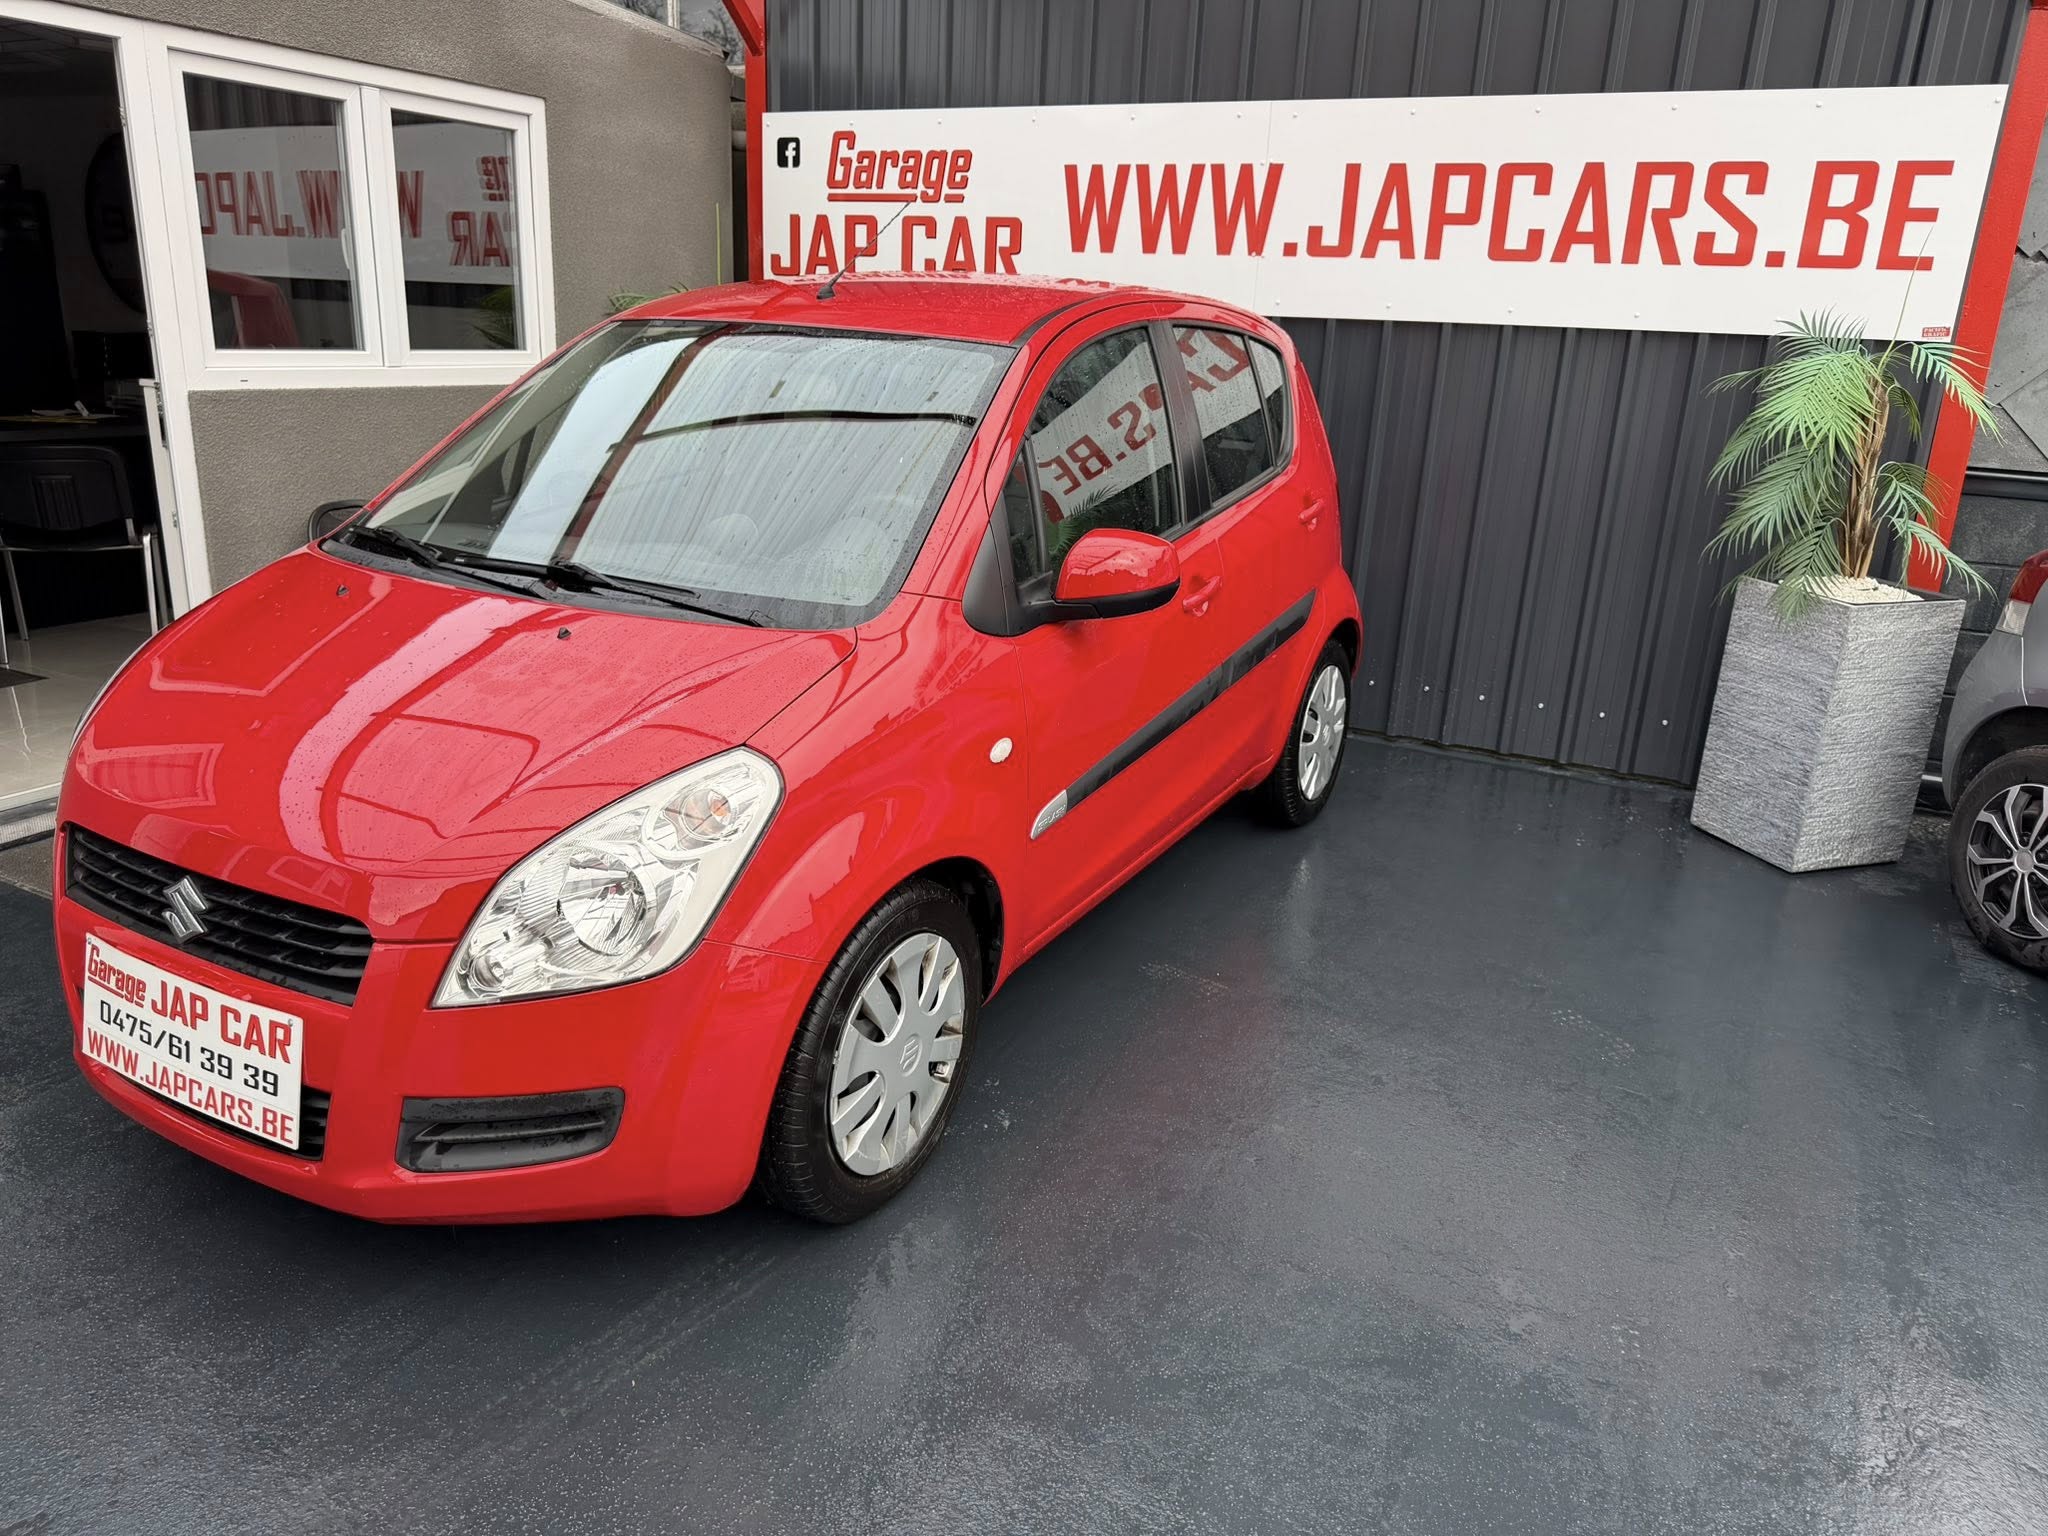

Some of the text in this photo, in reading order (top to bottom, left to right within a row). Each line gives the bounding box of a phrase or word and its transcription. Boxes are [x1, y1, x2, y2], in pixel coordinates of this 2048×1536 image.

[827, 130, 973, 202] Garage
[1064, 160, 1955, 270] WWW.JAPCARS.BE
[771, 214, 1022, 276] JAP CAR
[88, 944, 292, 1064] Garage JAP CAR
[100, 1000, 278, 1097] 0475/61 39 39
[87, 1027, 294, 1144] WWW.JAPCARS.BE
